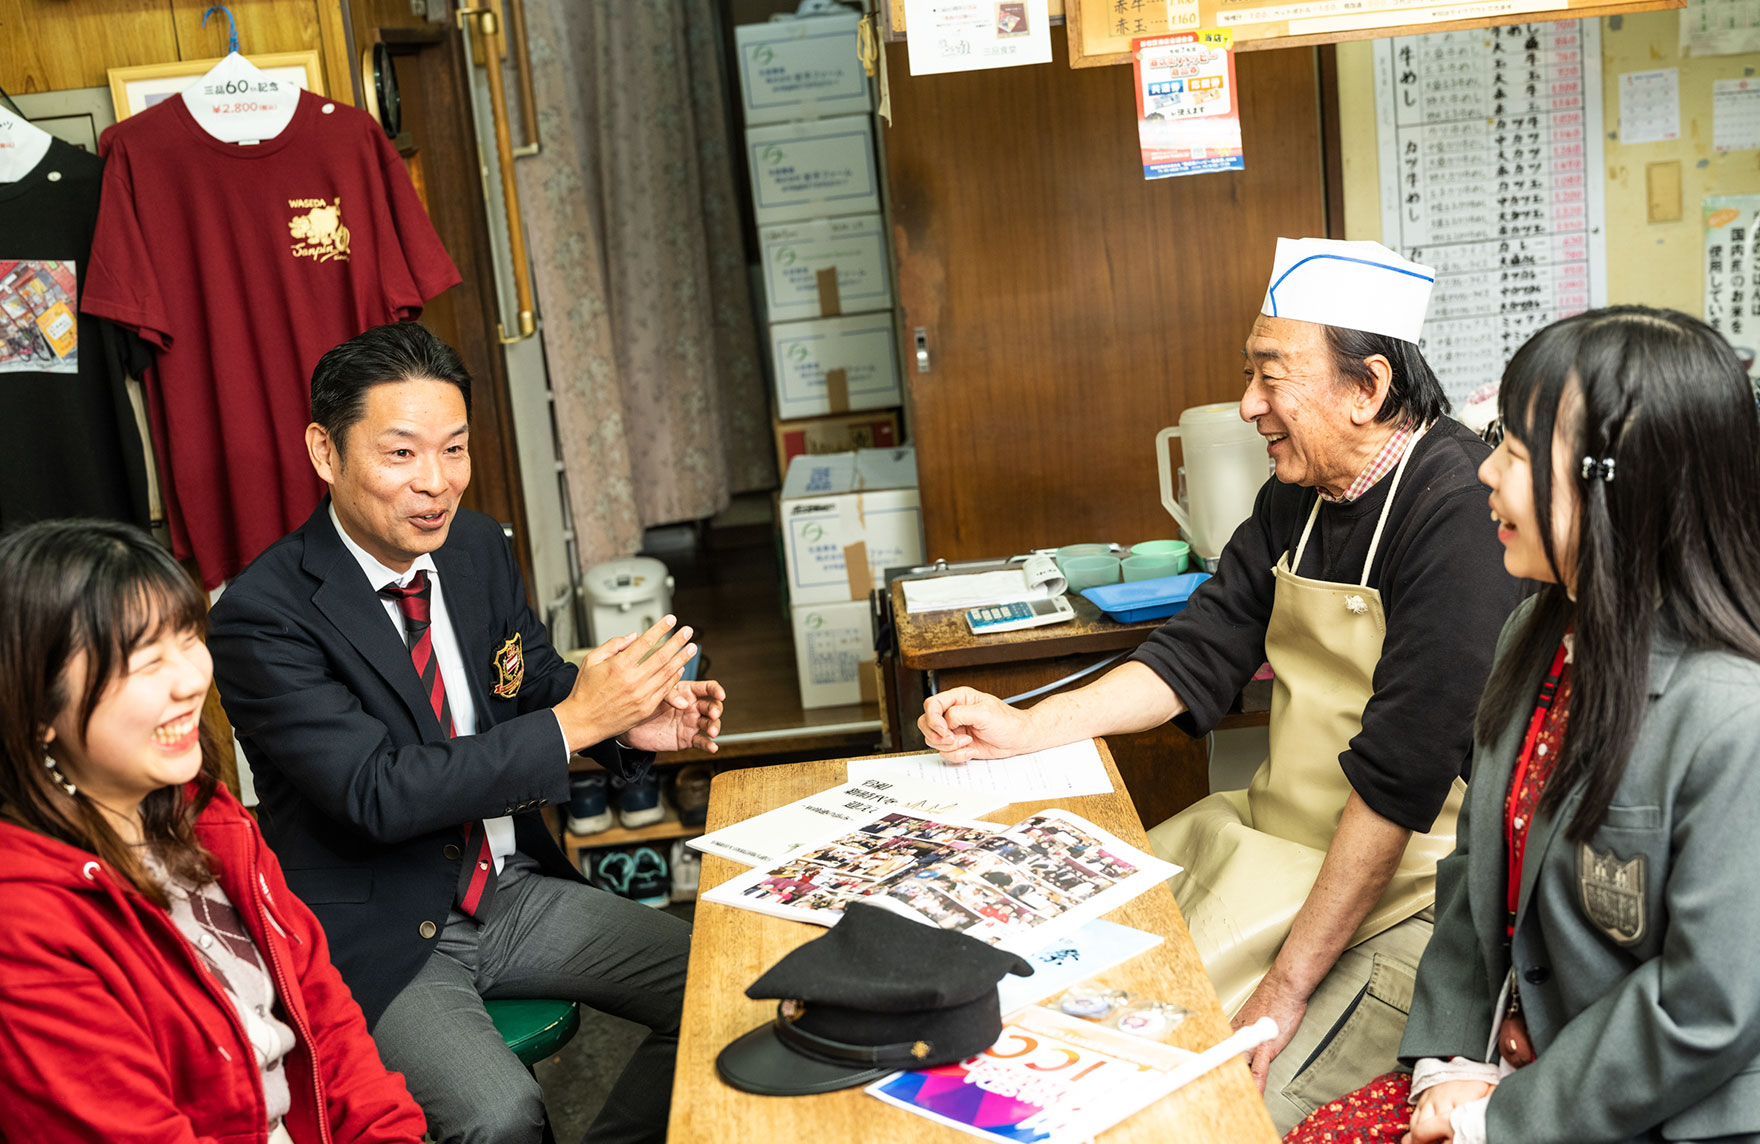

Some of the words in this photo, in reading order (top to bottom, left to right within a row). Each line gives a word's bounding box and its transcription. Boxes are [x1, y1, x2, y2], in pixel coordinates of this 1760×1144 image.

[1115, 18, 1148, 35] 赤玉
[1399, 44, 1418, 107] 牛めし
[1496, 115, 1539, 130] カツ牛
[1495, 131, 1540, 146] 中カツ
[1496, 147, 1541, 162] 大カツ
[1404, 140, 1420, 222] カツ牛めし
[288, 198, 327, 209] WASEDA
[1499, 240, 1546, 252] カレー
[1708, 244, 1723, 330] 使用していま
[1731, 228, 1746, 335] 国内産のお米を
